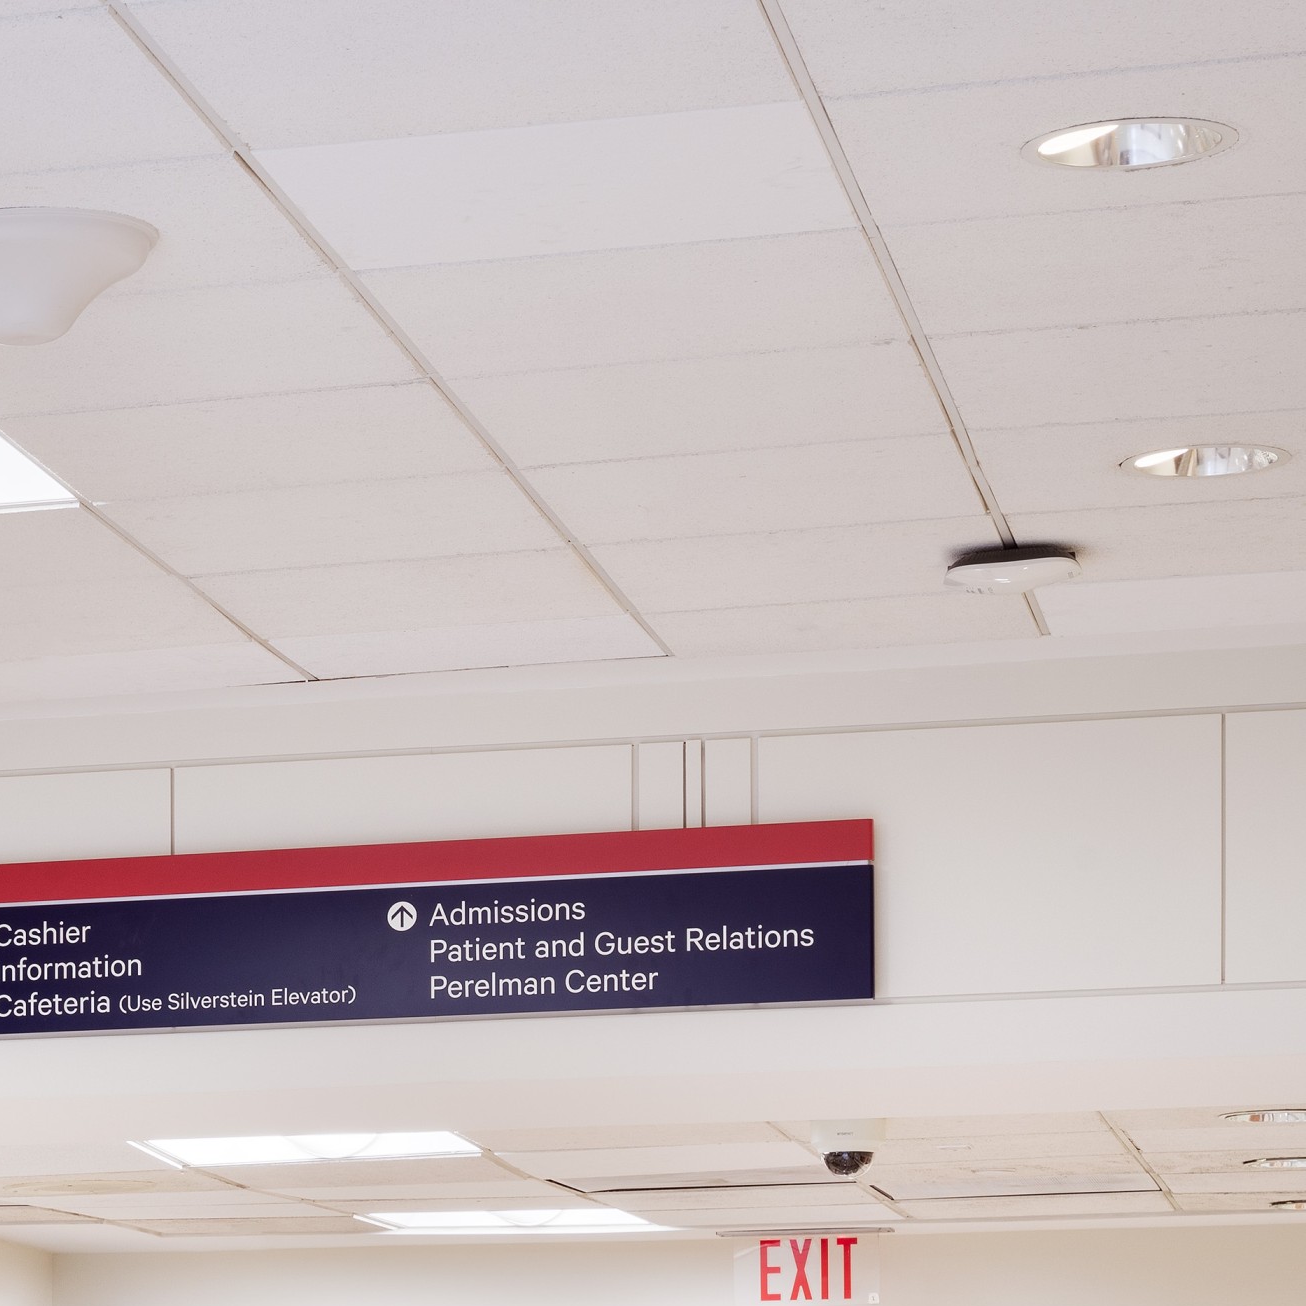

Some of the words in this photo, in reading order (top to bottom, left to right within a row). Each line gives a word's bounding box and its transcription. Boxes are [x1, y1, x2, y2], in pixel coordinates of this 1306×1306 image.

[428, 898, 586, 927] Admissions
[430, 937, 526, 963] Patient
[534, 931, 585, 959] and
[594, 930, 676, 956] Guest
[686, 924, 815, 952] Relations
[119, 994, 163, 1014] (Use
[167, 989, 265, 1011] Silverstein
[271, 985, 357, 1006] Elevator)
[430, 971, 556, 1000] Perelman
[565, 969, 659, 994] Center
[759, 1236, 858, 1302] EXIT
